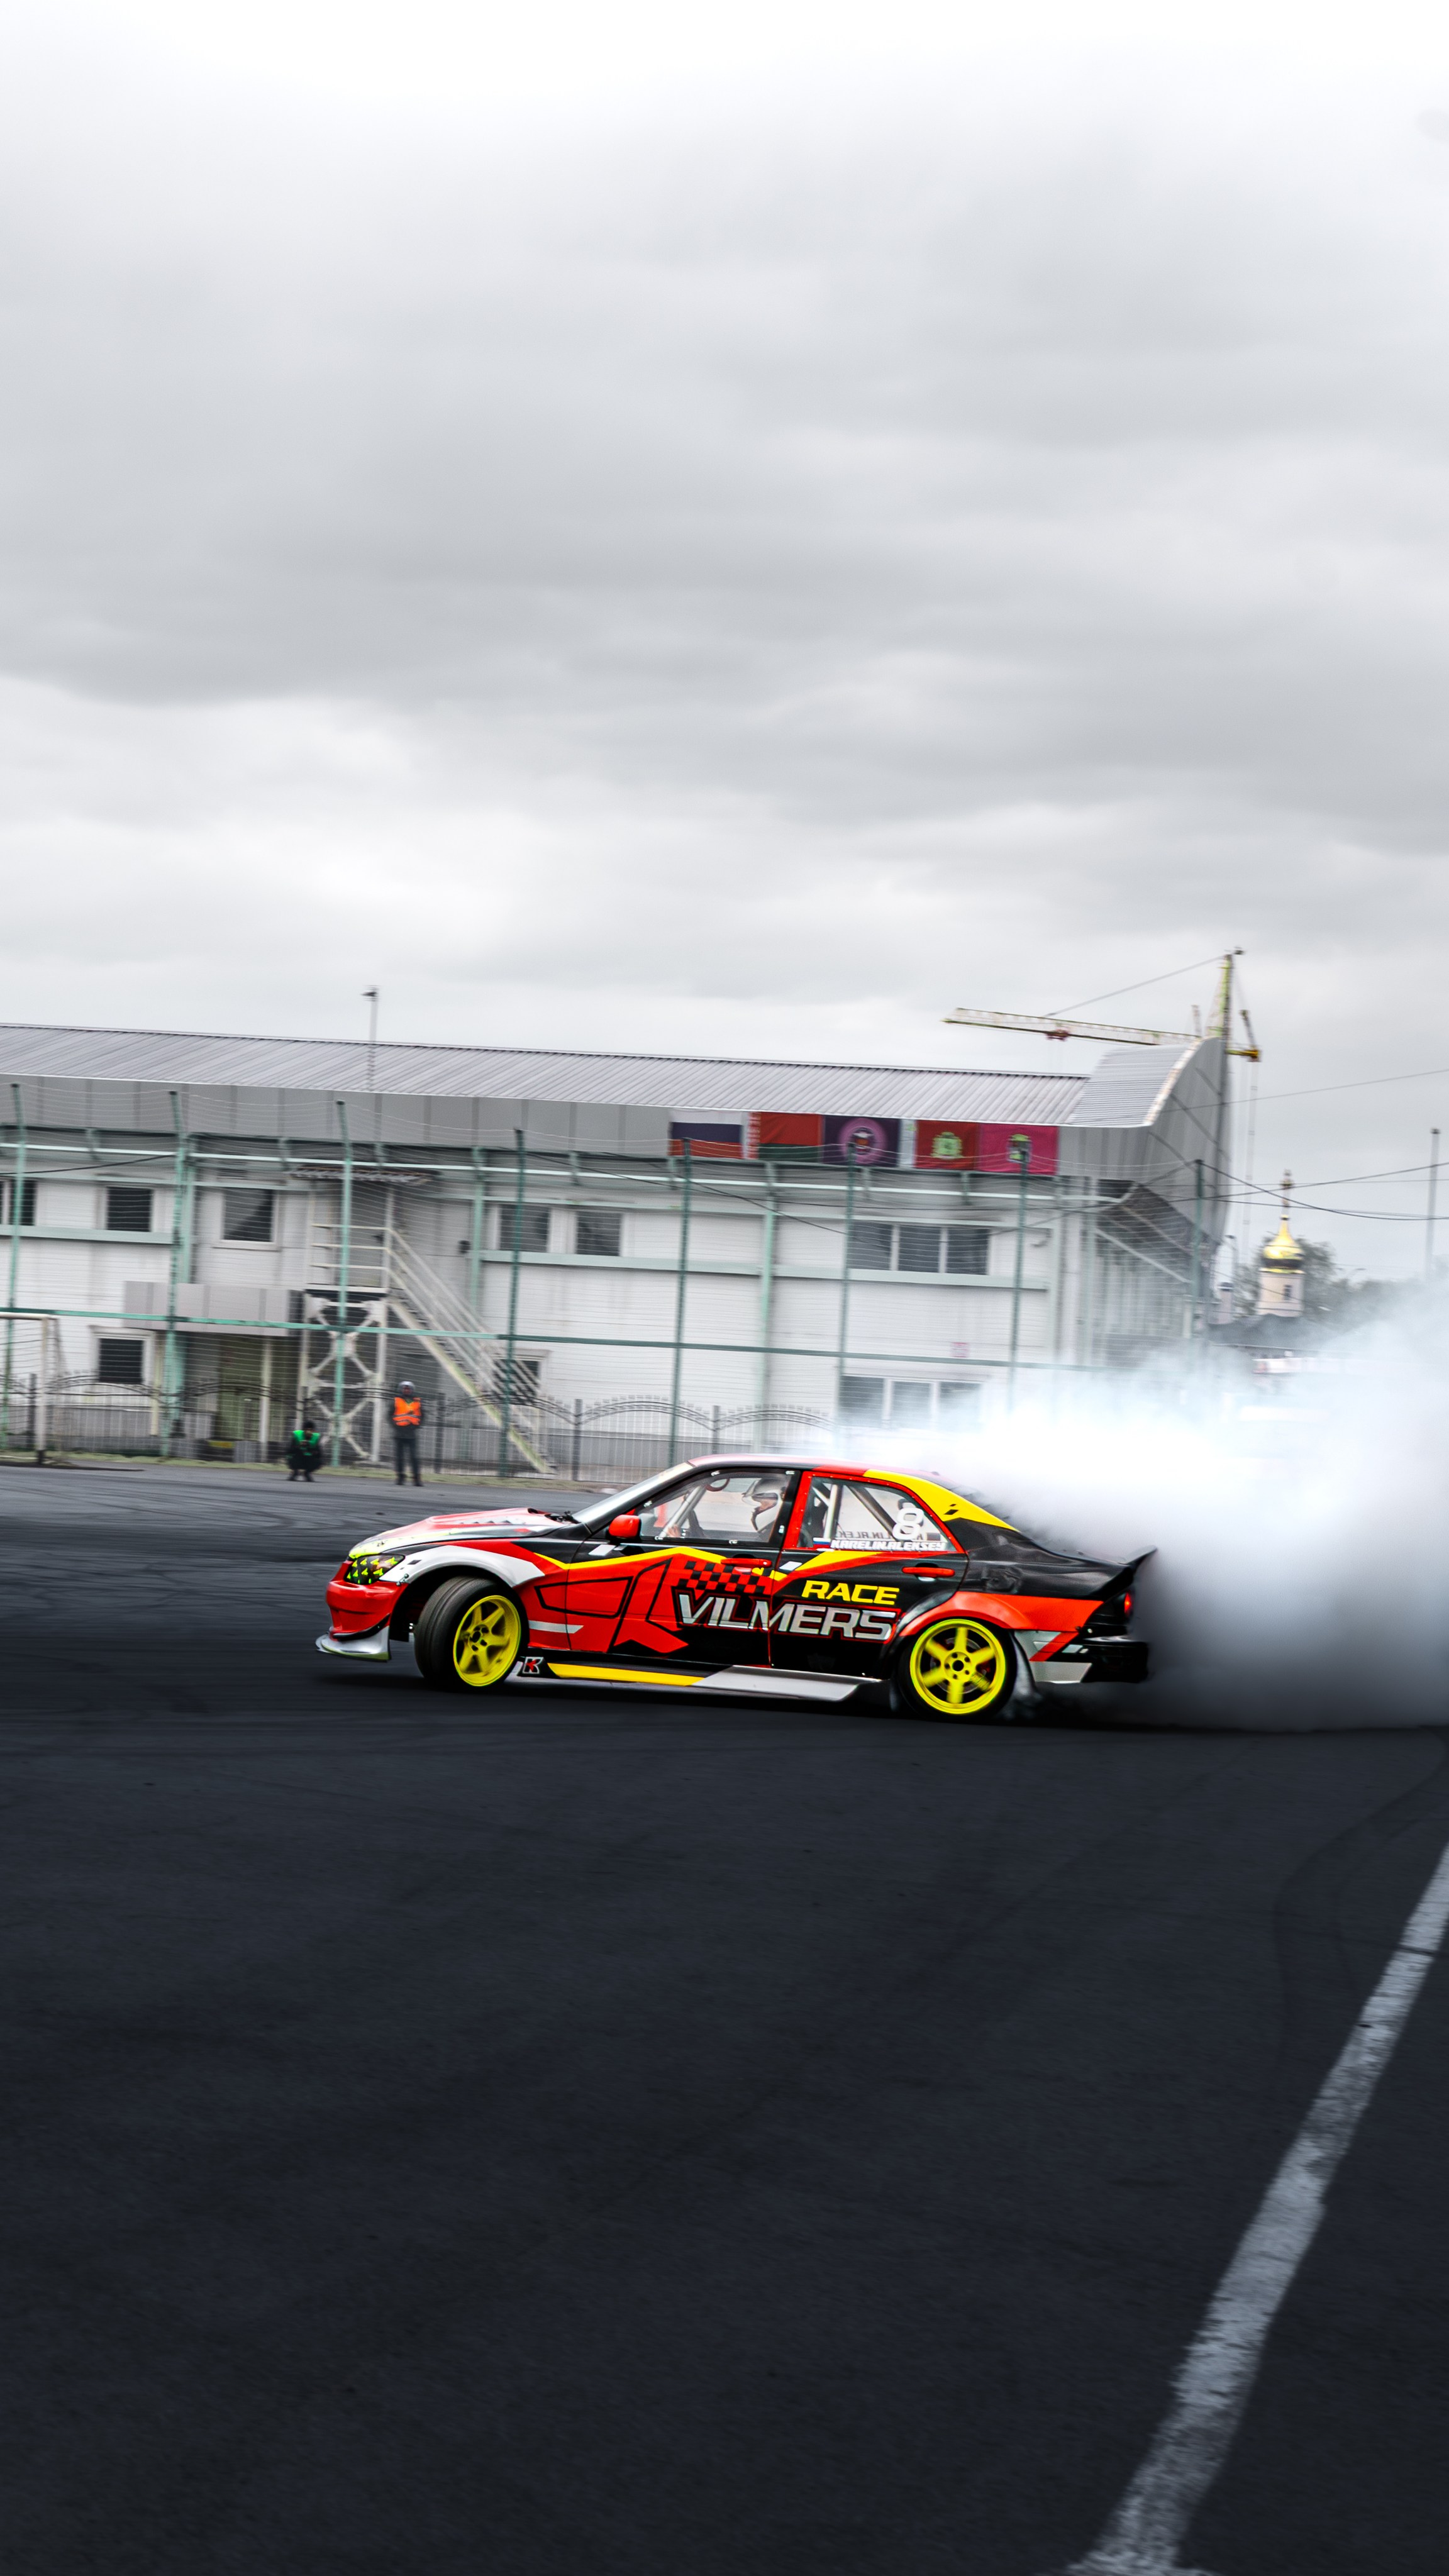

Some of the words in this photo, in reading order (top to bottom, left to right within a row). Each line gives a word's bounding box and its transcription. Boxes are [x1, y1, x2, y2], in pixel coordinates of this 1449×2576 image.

[892, 1507, 924, 1540] 8
[802, 1580, 899, 1604] RACE
[679, 1594, 897, 1640] VILMERS
